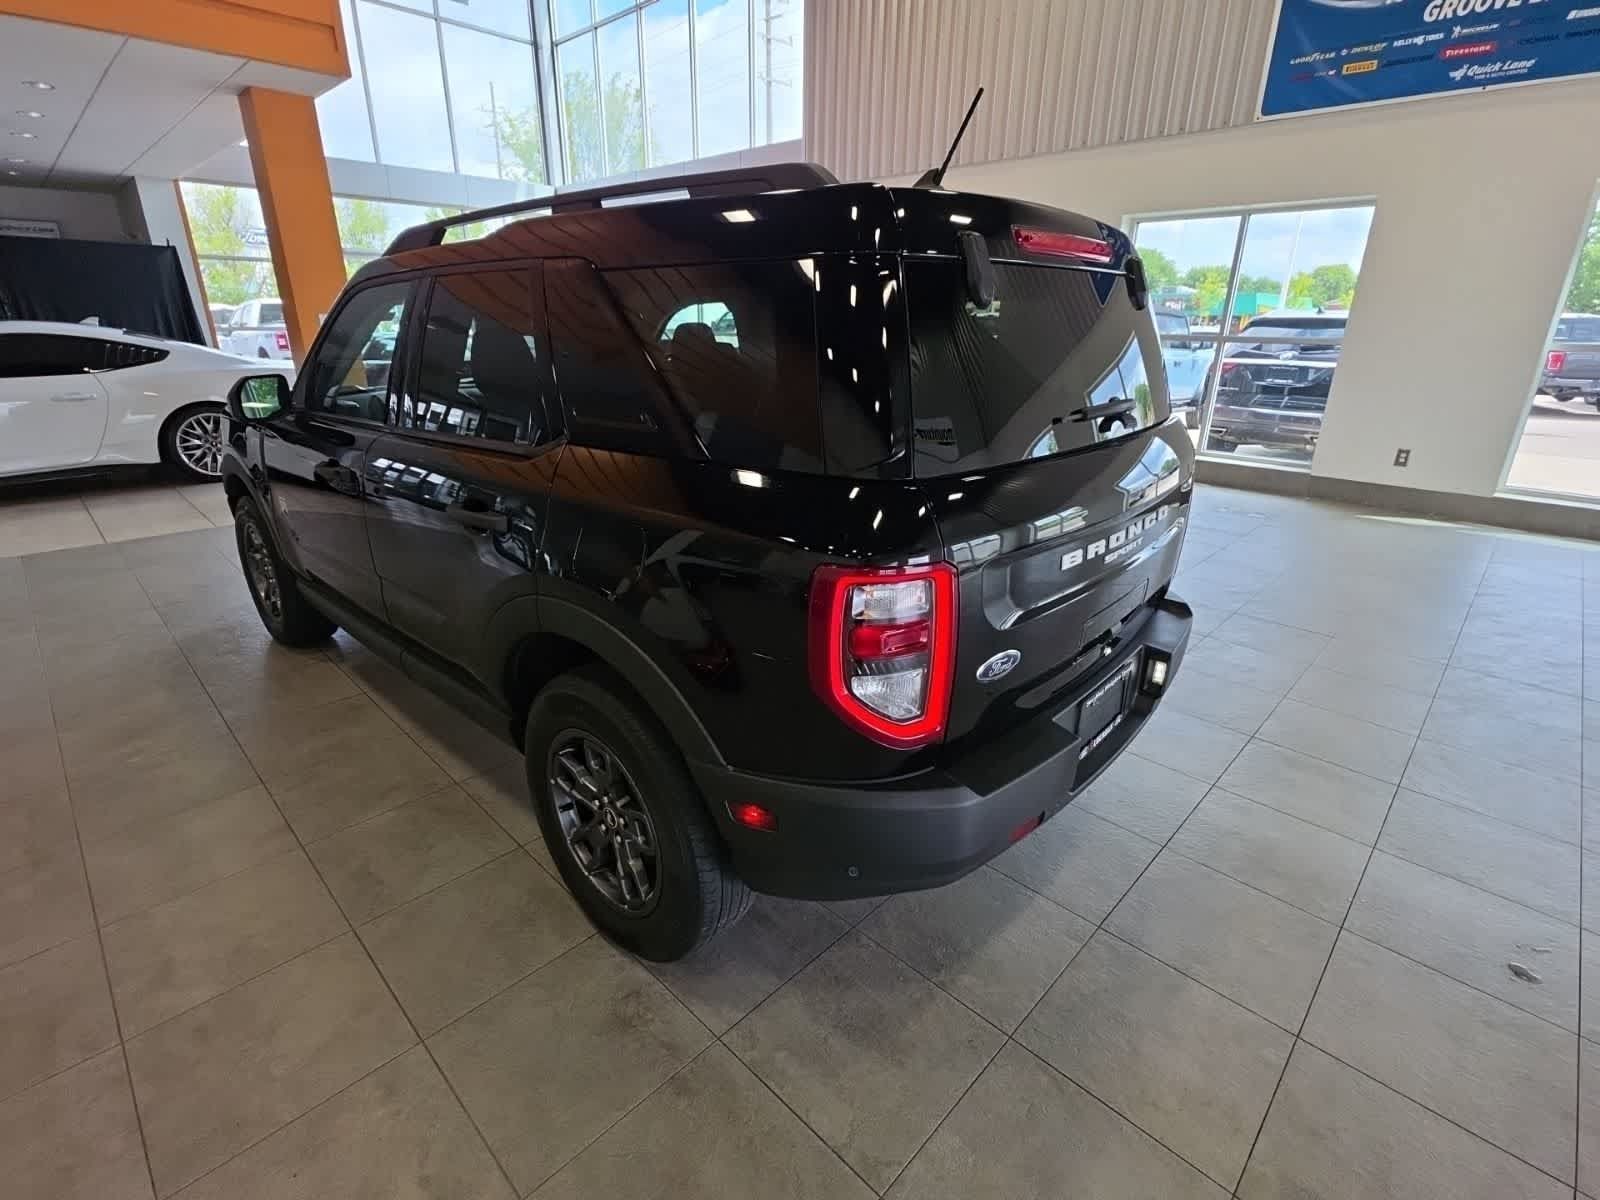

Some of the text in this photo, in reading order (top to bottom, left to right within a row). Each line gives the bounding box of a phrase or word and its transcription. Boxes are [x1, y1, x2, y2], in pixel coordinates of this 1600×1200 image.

[1467, 58, 1537, 76] Quick Lane
[1061, 505, 1169, 571] BRONCO
